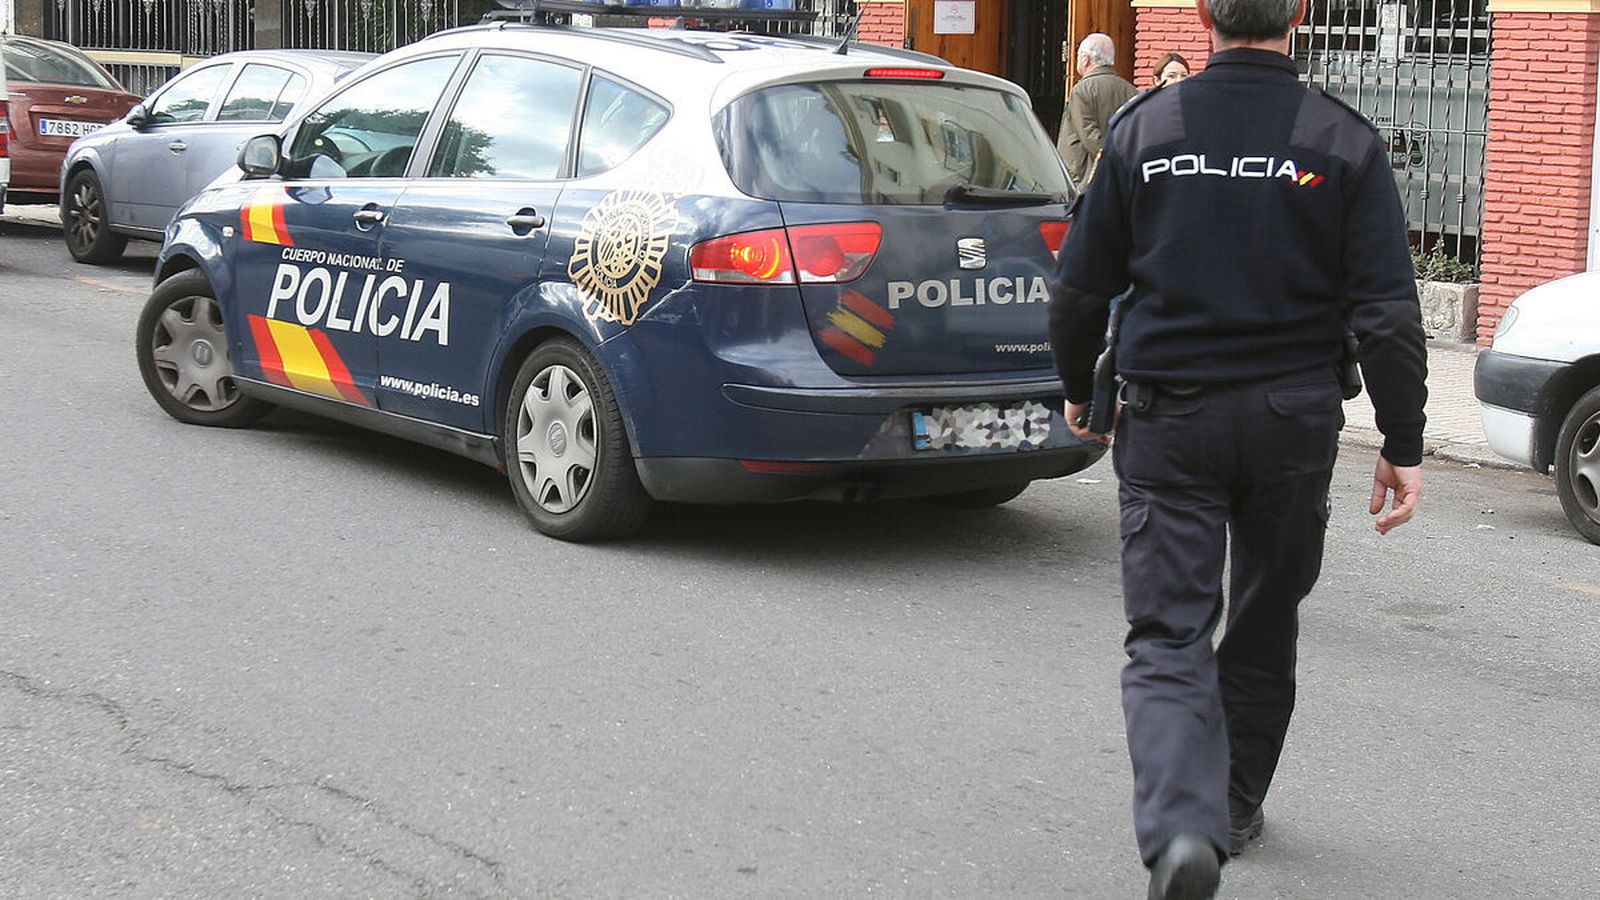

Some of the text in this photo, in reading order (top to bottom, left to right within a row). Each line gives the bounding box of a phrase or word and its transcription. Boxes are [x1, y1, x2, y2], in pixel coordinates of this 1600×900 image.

[48, 121, 80, 135] 7862
[1142, 154, 1298, 183] POLICIA
[281, 247, 405, 273] CUERPO NACIONAL DE
[266, 263, 450, 346] POLICIA
[887, 276, 1050, 309] POLICIA
[995, 341, 1051, 354] www.poli
[380, 375, 480, 406] www.policia.es
